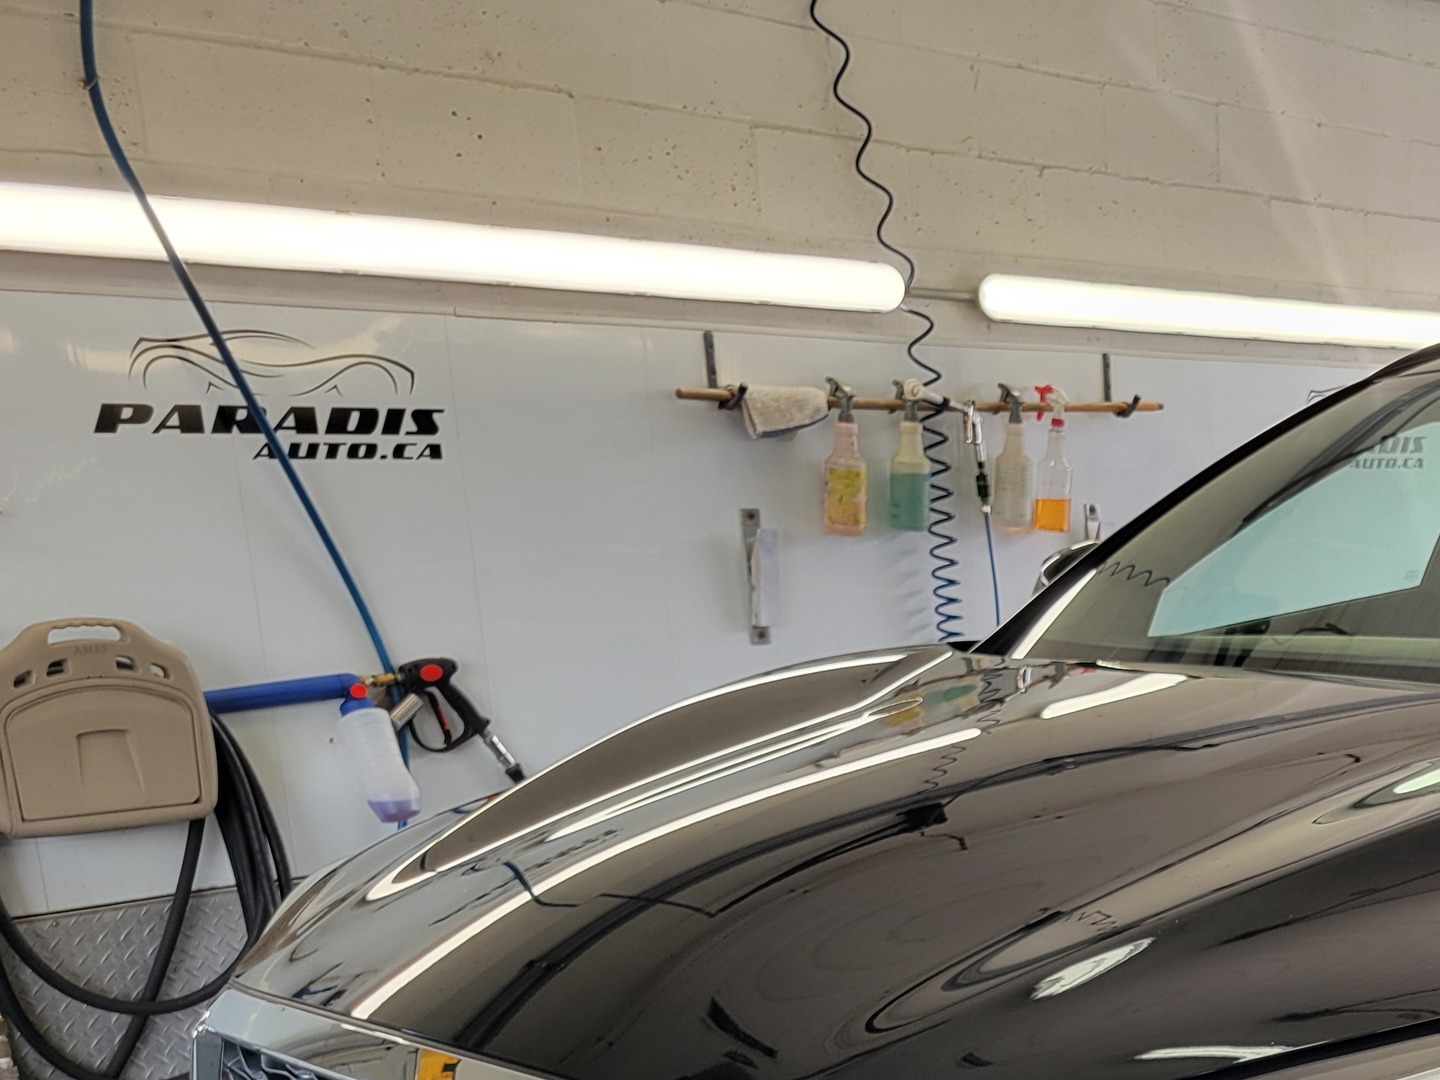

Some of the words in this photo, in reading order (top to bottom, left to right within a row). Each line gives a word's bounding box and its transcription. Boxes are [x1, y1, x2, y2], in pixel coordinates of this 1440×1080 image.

[94, 403, 444, 436] PARADIS
[252, 442, 442, 460] AUTO.CA
[1349, 457, 1424, 469] AUTO.CA
